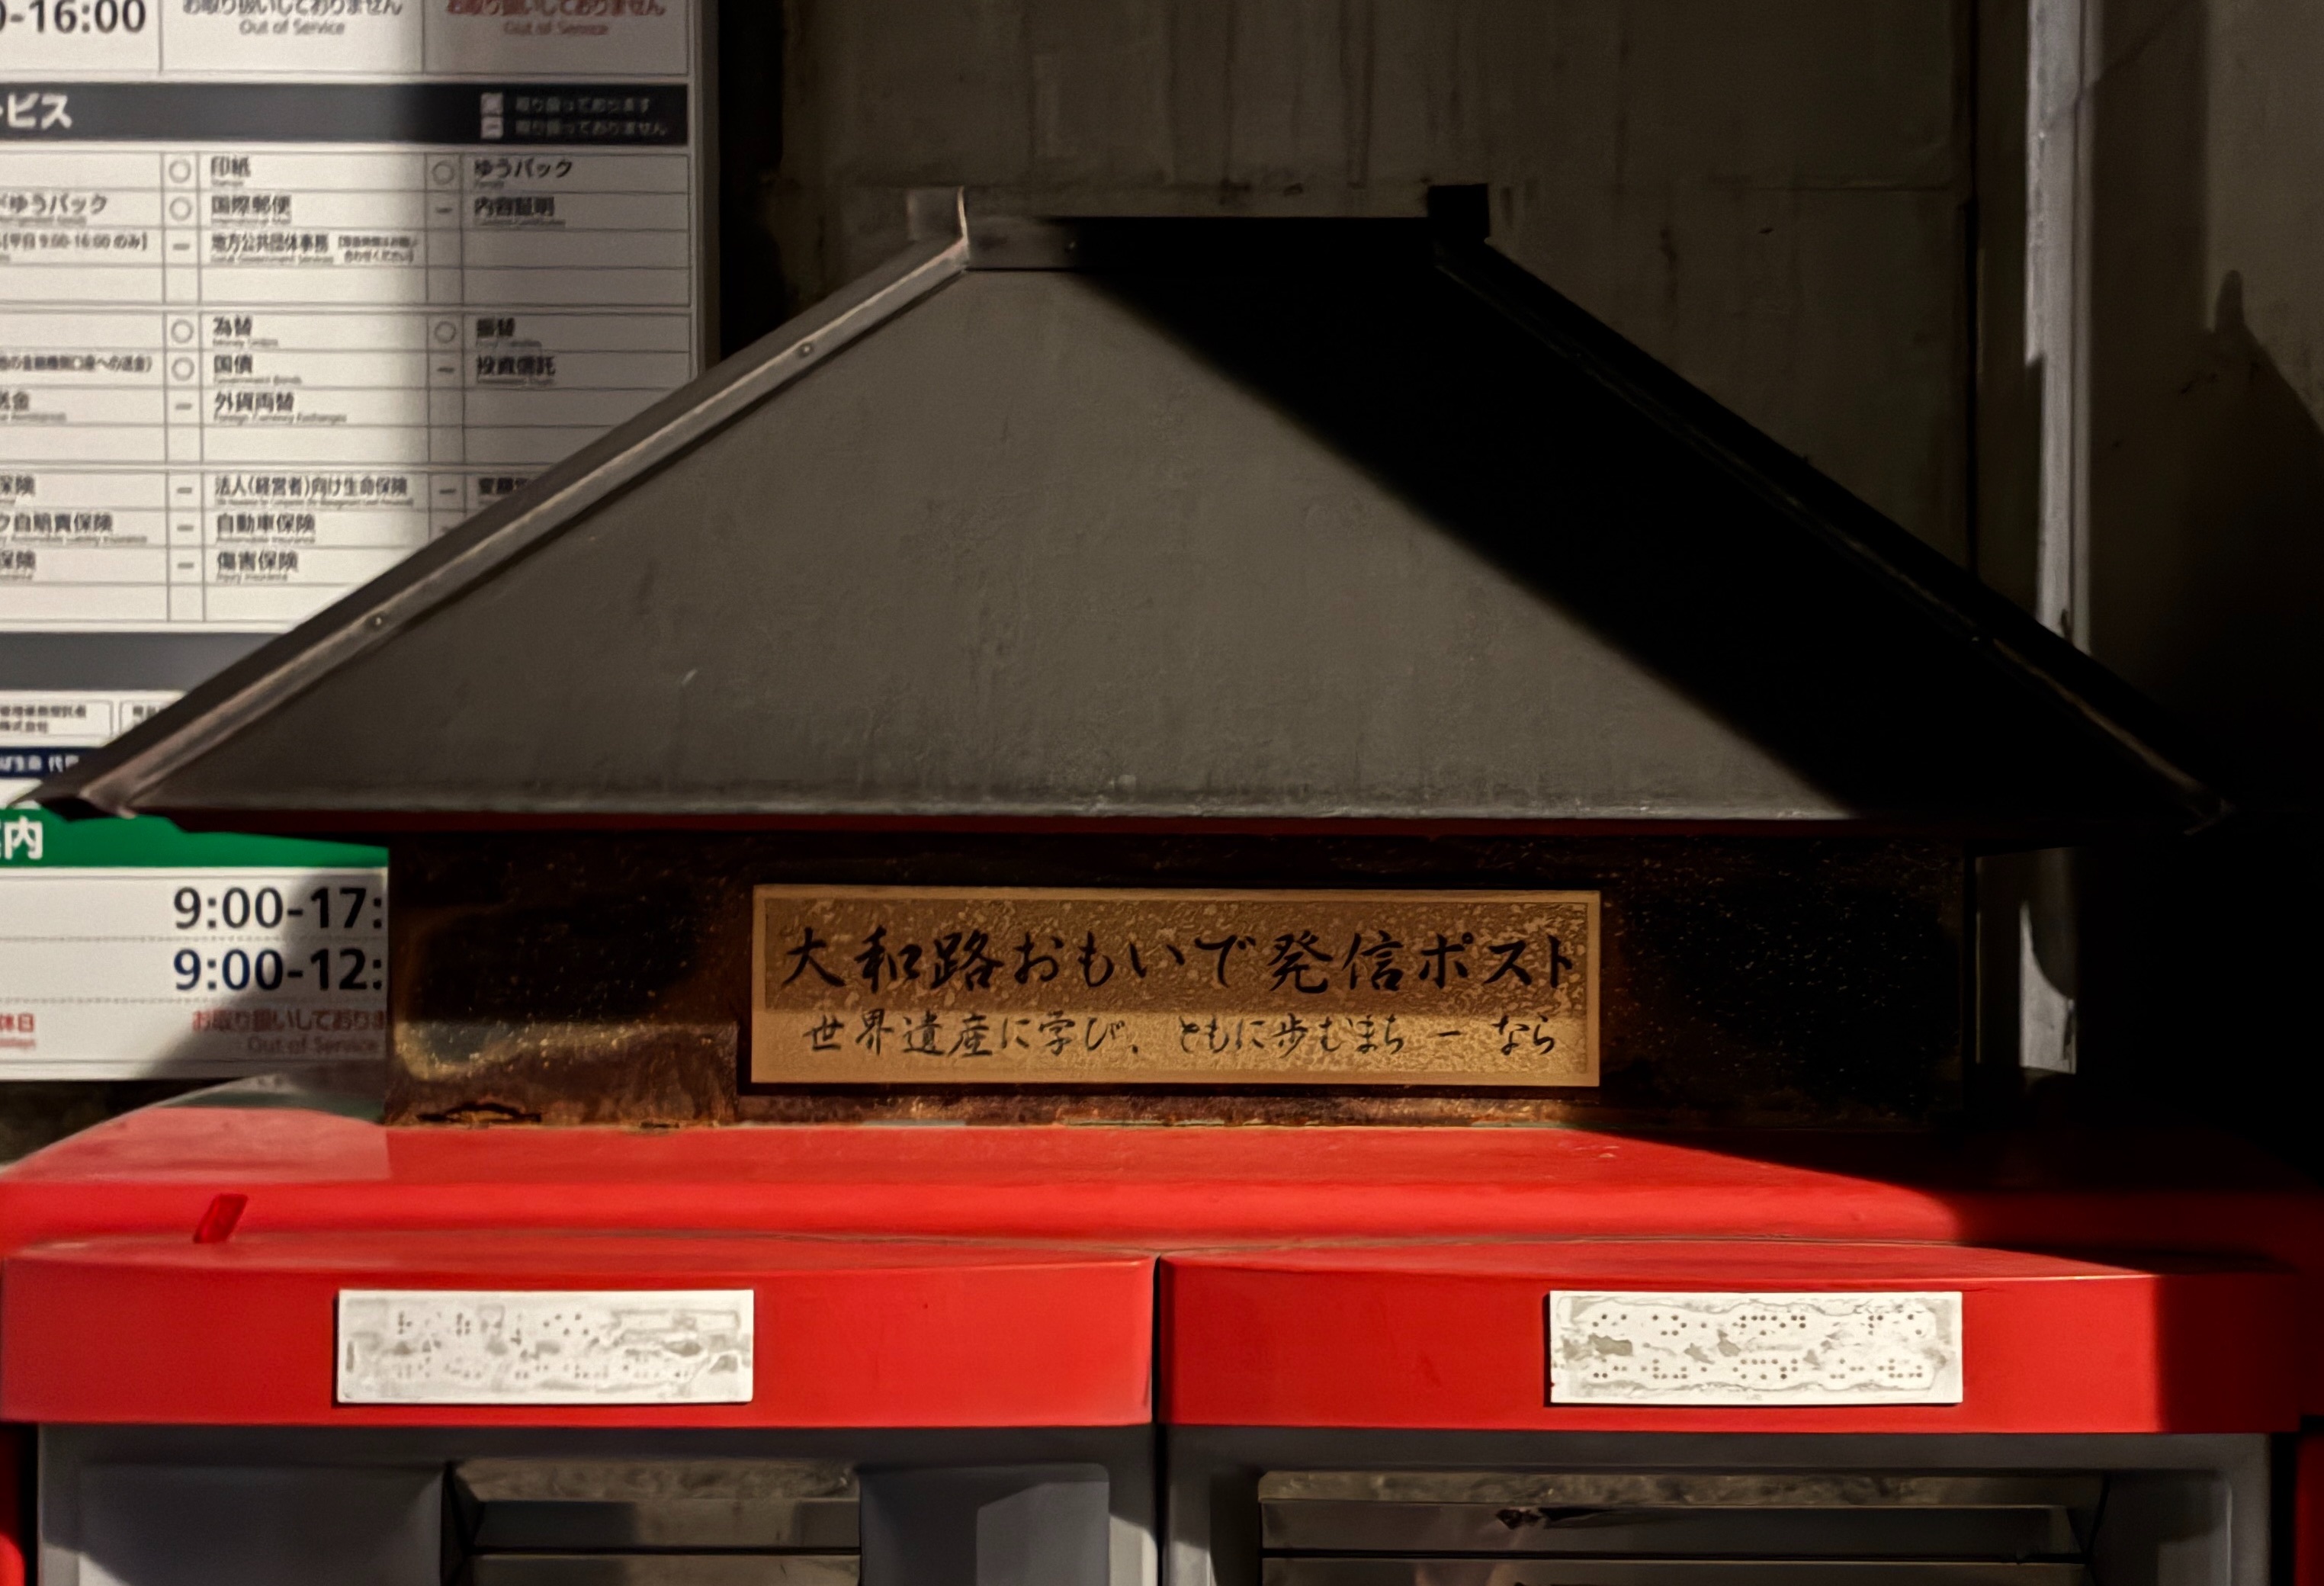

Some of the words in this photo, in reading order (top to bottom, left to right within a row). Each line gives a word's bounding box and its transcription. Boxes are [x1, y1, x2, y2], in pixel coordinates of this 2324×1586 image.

[0, 0, 146, 34] -16:00
[239, 19, 268, 35] Out
[272, 19, 289, 35] of
[293, 18, 345, 36] Service
[0, 92, 72, 130] ビス
[474, 157, 573, 179] ゆうパック
[173, 887, 382, 929] 9:00-17:
[173, 949, 382, 991] 9:00-12:
[782, 925, 1572, 994] 大和路おもいで発信ポスト
